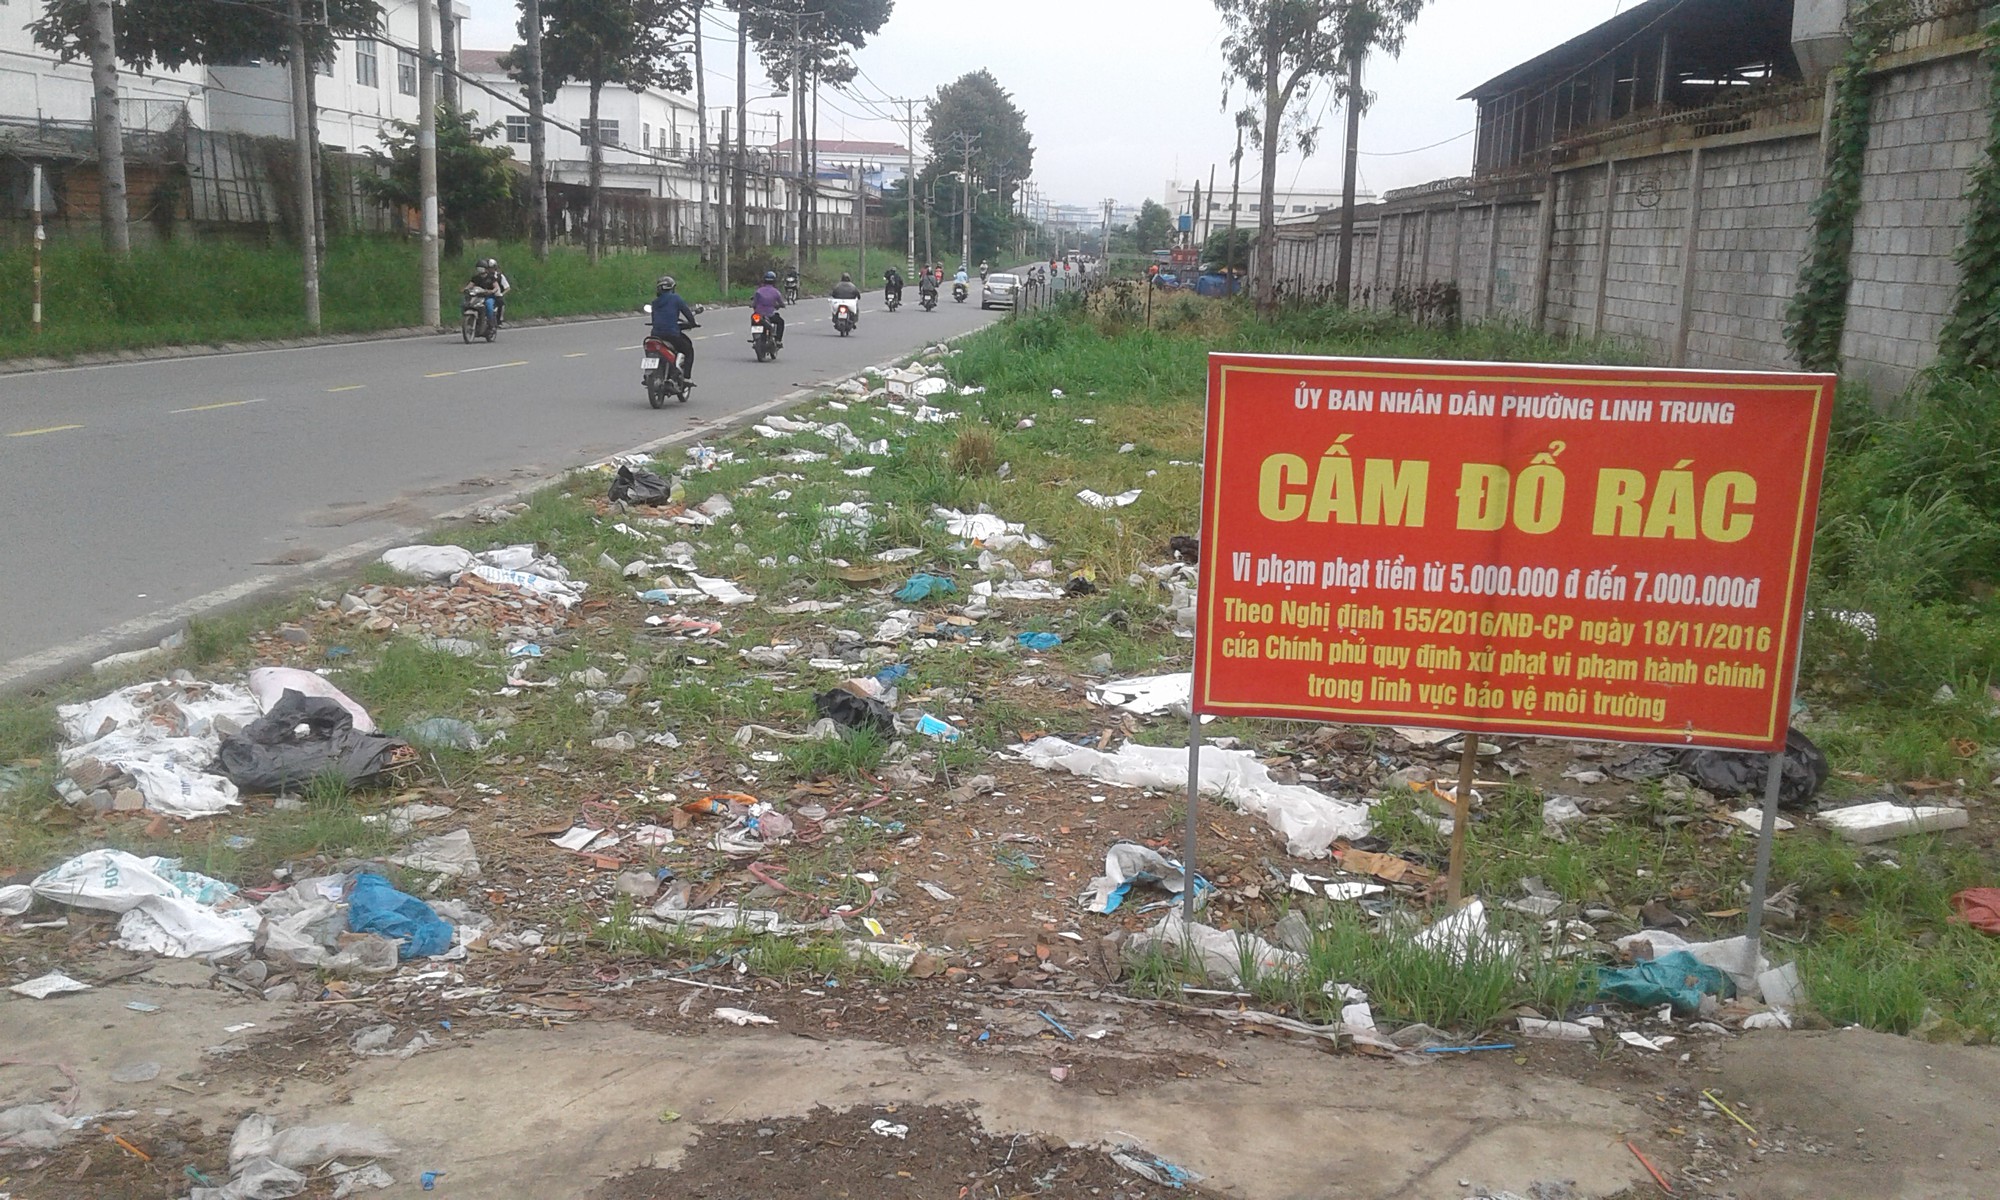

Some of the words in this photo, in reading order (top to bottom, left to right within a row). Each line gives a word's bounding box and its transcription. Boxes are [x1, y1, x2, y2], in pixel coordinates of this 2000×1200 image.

[1294, 381, 1322, 410] ỦY
[1328, 389, 1374, 412] BAN
[1379, 389, 1442, 414] NHÂN
[1448, 391, 1495, 416] DÂN
[1501, 392, 1593, 421] PHƯỜNG
[1600, 399, 1653, 422] LINH
[1660, 401, 1735, 425] TRUNG
[1258, 433, 1430, 528] CẤM
[1455, 440, 1567, 534] ĐỔ
[1592, 459, 1757, 543] RÁC
[1232, 552, 1251, 583] Vi
[1256, 554, 1316, 591] phạm
[1321, 557, 1369, 594] phạt
[1375, 554, 1416, 590] tiền
[1423, 560, 1446, 592] từ
[1450, 563, 1559, 598] 5.000.000
[1564, 569, 1581, 598] đ
[1585, 565, 1627, 601] đến
[1633, 572, 1761, 609] 7.000.000đ
[1223, 597, 1274, 625] Theo
[1280, 600, 1331, 633] Nghị
[1337, 603, 1384, 637] định
[1392, 607, 1574, 641] 155/2016/NĐ-CP
[1579, 617, 1635, 647] ngày
[1643, 619, 1772, 652] 18/11/2016
[1222, 631, 1259, 660] của
[1265, 635, 1323, 663] Chính
[1328, 637, 1367, 665] phủ
[1372, 646, 1411, 670] quy
[1415, 643, 1461, 675] định
[1466, 645, 1496, 674] xử
[1499, 649, 1547, 681] phạt
[1552, 651, 1571, 676] vi
[1576, 653, 1638, 685] phạm
[1644, 655, 1699, 685] hành
[1704, 660, 1766, 690] chính
[1308, 673, 1364, 703] trong
[1370, 676, 1412, 703] lĩnh
[1418, 682, 1458, 710] vực
[1463, 680, 1505, 710] bảo
[1511, 687, 1538, 716] vệ
[1543, 686, 1587, 714] môi
[1593, 689, 1667, 722] trường
